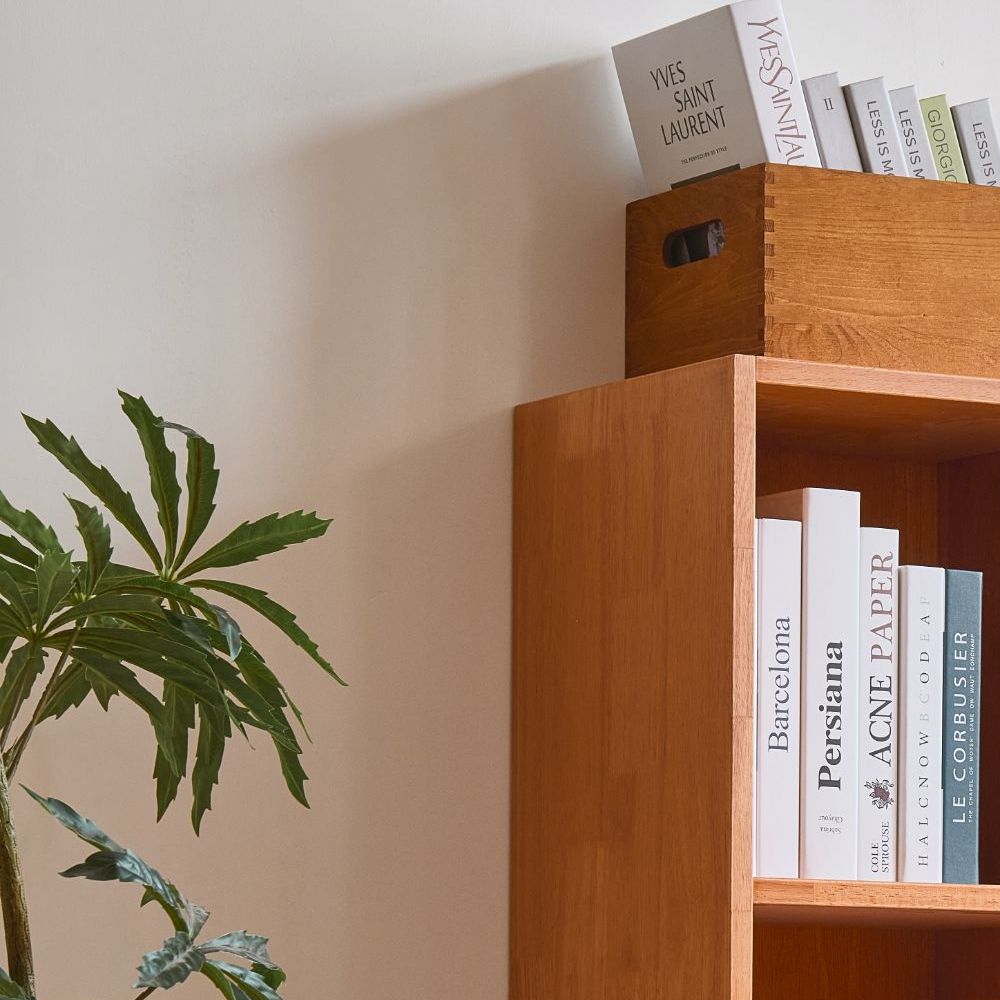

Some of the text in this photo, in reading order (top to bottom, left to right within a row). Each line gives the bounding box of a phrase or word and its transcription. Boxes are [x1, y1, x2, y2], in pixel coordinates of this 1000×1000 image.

[650, 60, 686, 91] YVES
[674, 79, 716, 113] SAINT
[661, 105, 727, 146] LAURENT
[867, 100, 896, 176] LESS IS M
[898, 109, 917, 147] LESS
[908, 150, 921, 165] IS
[972, 122, 990, 160] LESS
[982, 162, 995, 178] IS
[769, 616, 791, 753] Barcelona
[869, 552, 894, 767] ACNE PAPER
[818, 640, 844, 790] Persiana
[952, 632, 968, 823] LE CORBUSIER
[871, 842, 880, 874] COLE
[881, 821, 890, 874] SPROUSE
